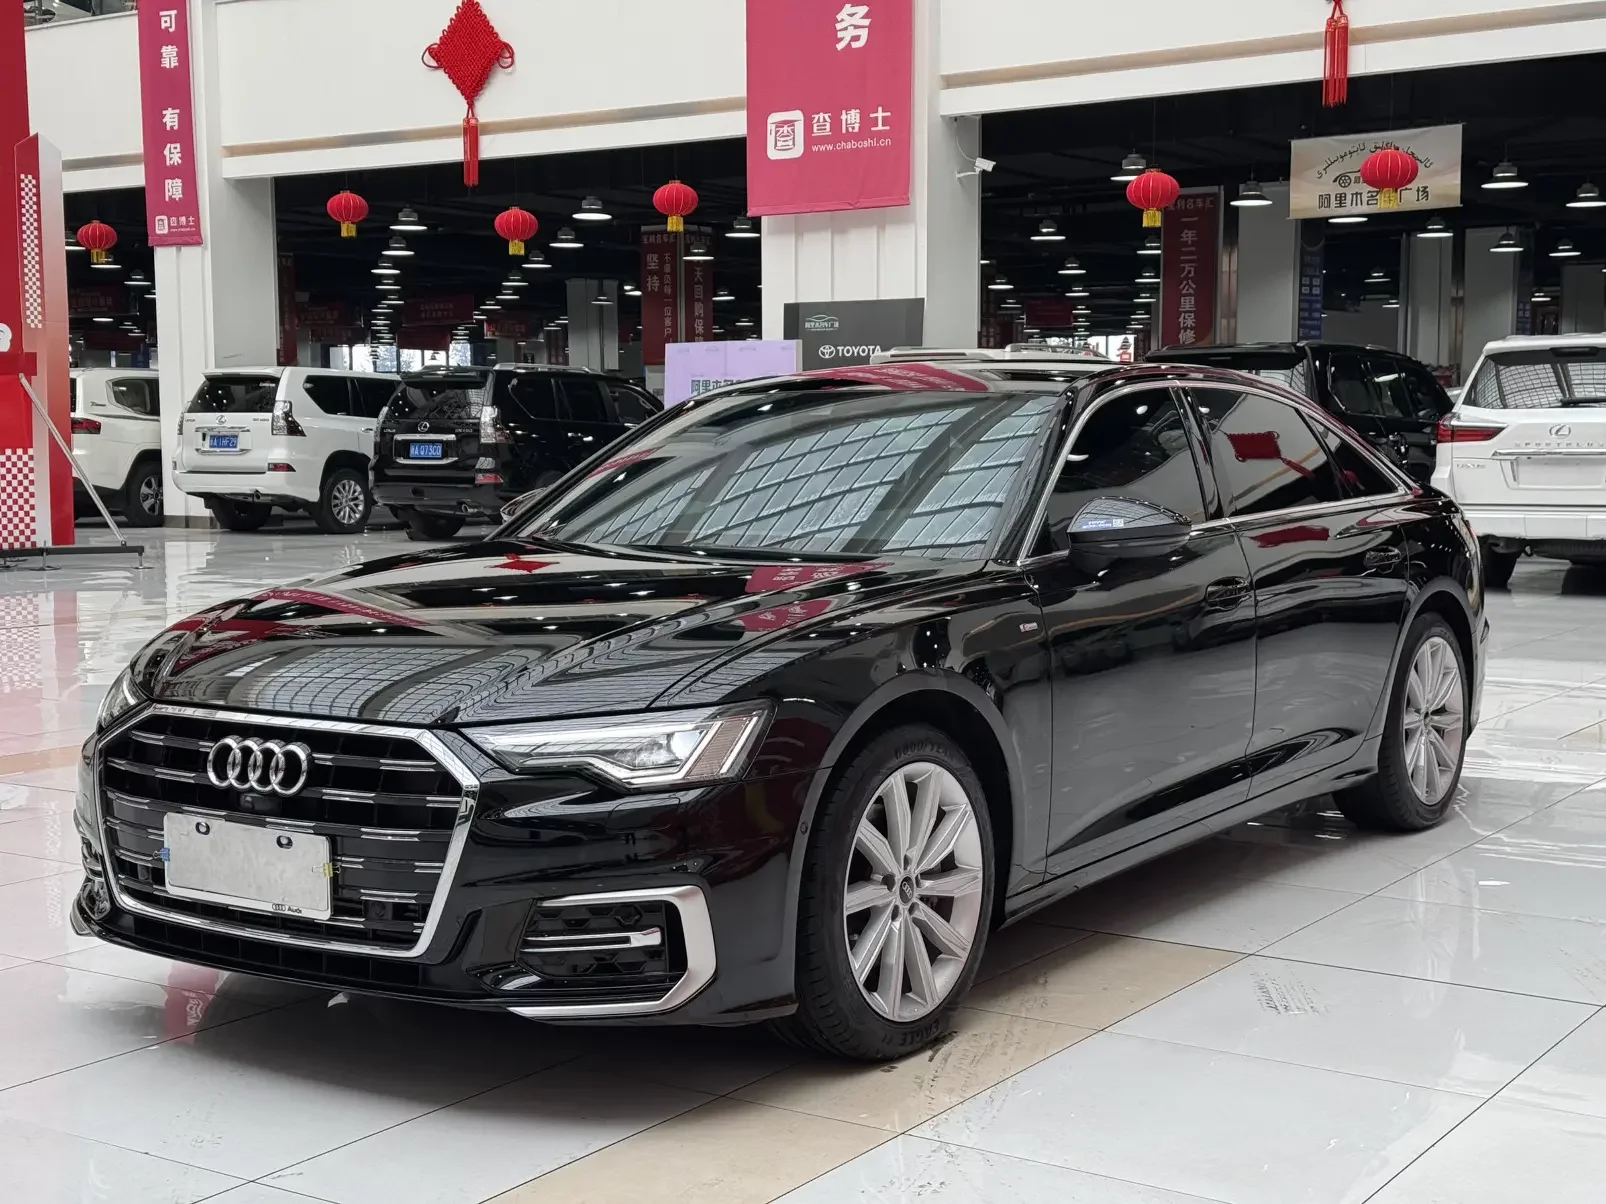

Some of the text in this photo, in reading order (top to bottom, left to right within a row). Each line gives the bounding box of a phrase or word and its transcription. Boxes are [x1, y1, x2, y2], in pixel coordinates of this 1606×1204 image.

[158, 9, 179, 70] 可靠
[835, 3, 872, 50] 务
[811, 106, 892, 137] 查博士
[161, 107, 183, 202] 有保障
[811, 137, 892, 152] www.chaboshi.cn
[1318, 185, 1430, 209] 阿里木名广场
[646, 253, 660, 292] 坚持
[1178, 216, 1198, 344] 一年二万公里保修
[837, 345, 882, 357] TOYOTA
[287, 905, 302, 913] Audi
